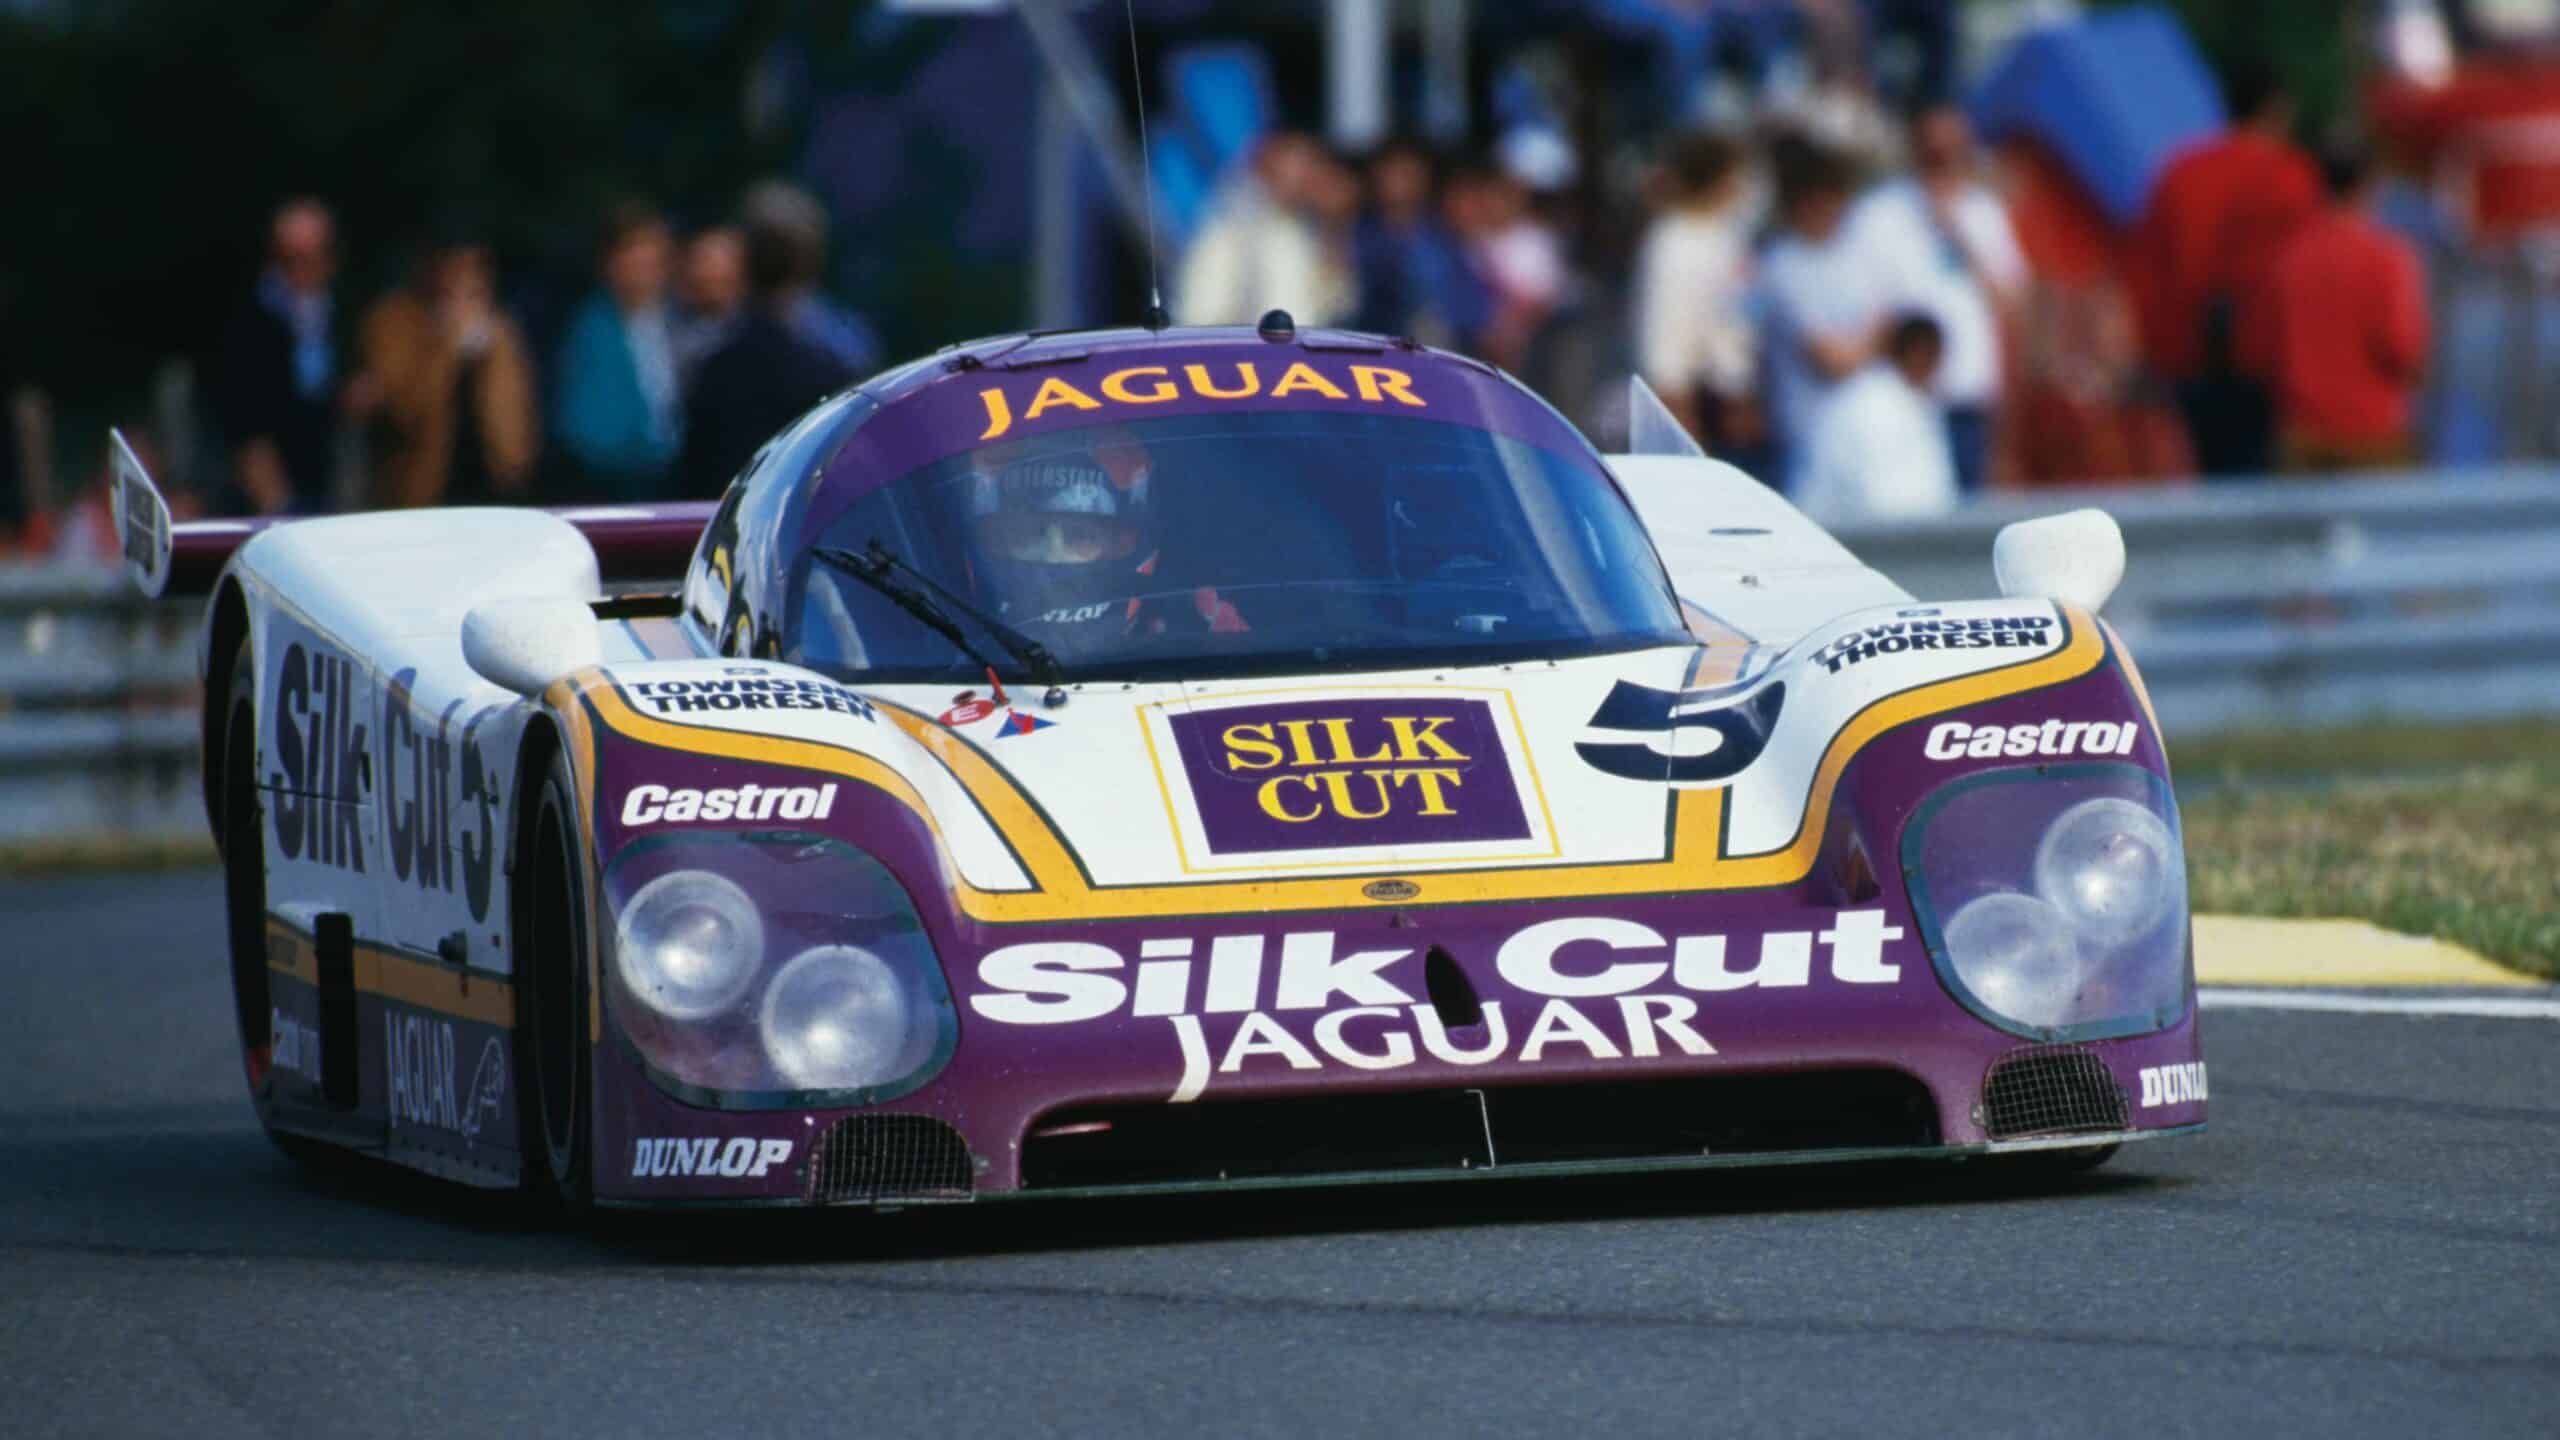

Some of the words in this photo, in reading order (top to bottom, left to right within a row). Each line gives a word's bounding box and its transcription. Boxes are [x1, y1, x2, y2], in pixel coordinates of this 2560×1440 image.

[978, 362, 1427, 441] JAGUAR
[1808, 616, 2053, 664] TOWNSEND
[1825, 631, 2050, 675] THORESEN
[646, 693, 876, 724] THORESEN
[1573, 678, 1785, 782] 5
[1221, 715, 1472, 771] SILK
[1924, 719, 2138, 761] Castrol
[270, 642, 372, 874] Silk
[385, 666, 465, 894] Cut
[1256, 768, 1463, 823] CUT
[460, 702, 498, 924] 5
[621, 783, 839, 826] Castrol
[969, 931, 1416, 1026] Silk
[1496, 909, 1903, 998] Cut
[383, 1006, 459, 1131] JAGUAR
[1167, 993, 1718, 1103] JAGUAR
[2139, 1061, 2208, 1108] DUNL
[632, 1137, 793, 1177] DUNLOP
